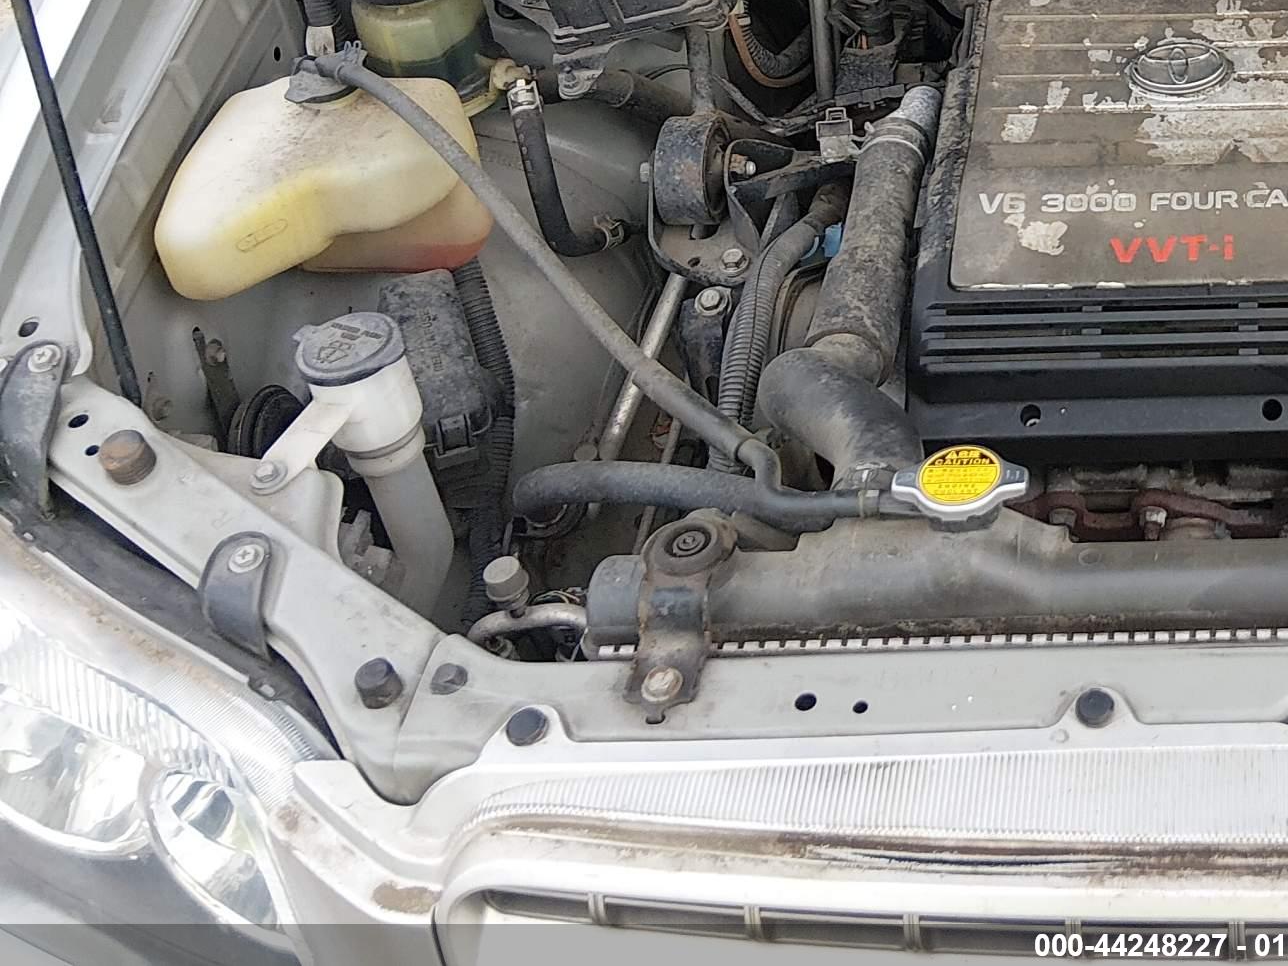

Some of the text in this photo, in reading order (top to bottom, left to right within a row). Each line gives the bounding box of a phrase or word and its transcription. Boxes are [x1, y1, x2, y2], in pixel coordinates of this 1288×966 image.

[979, 192, 1027, 215] V6
[1041, 192, 1138, 213] 3000
[1150, 191, 1239, 212] FOUR
[1109, 234, 1235, 263] VVT-i
[935, 458, 990, 466] CAUTION
